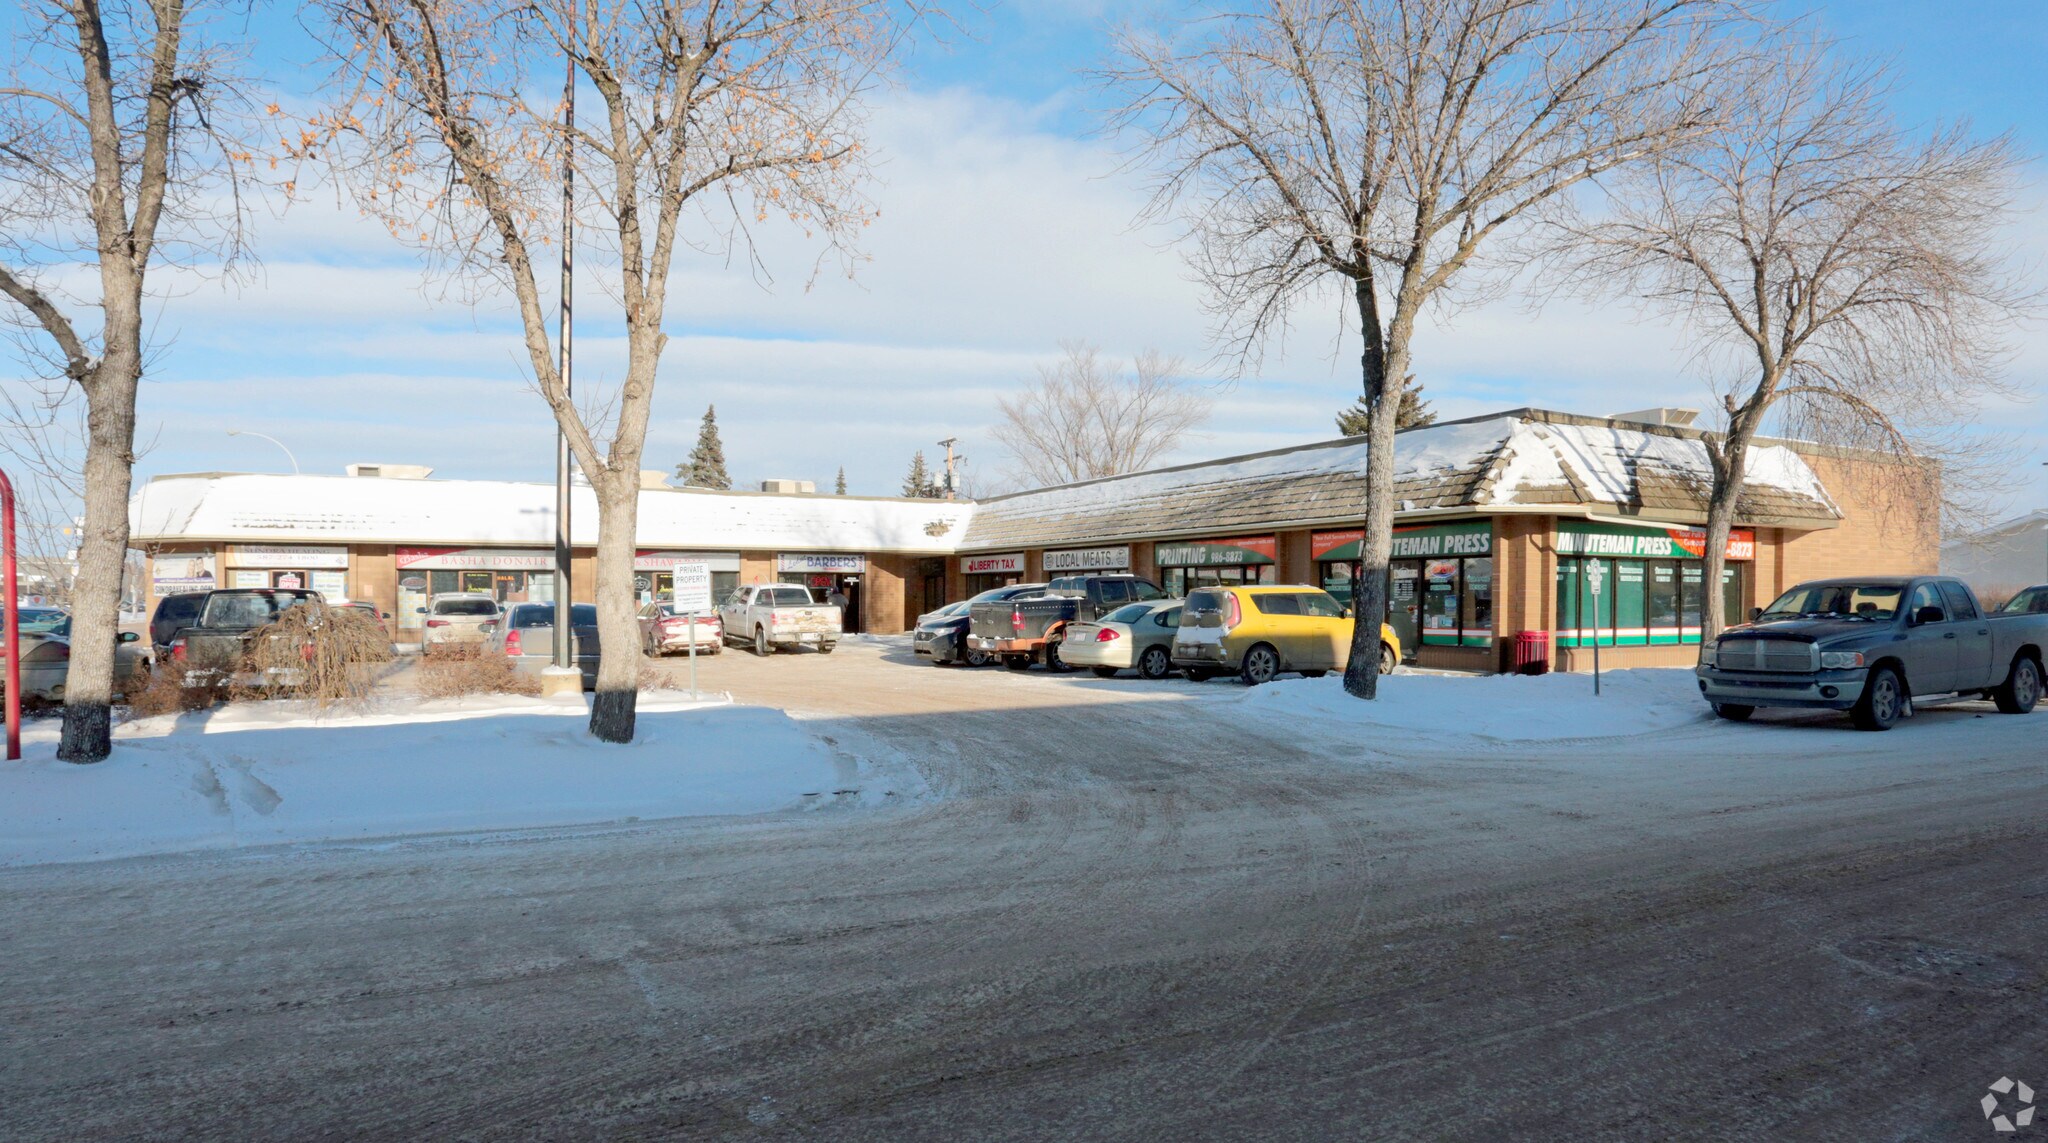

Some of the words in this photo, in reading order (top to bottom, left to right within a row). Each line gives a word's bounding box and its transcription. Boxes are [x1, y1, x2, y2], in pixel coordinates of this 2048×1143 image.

[1444, 533, 1490, 553] PRESS
[1557, 532, 1634, 554] MINUTEMAN
[1636, 536, 1673, 555] PRESS
[441, 556, 486, 565] BASHA
[493, 557, 547, 566] DONAIR
[1056, 553, 1080, 567] LOCAL
[1158, 546, 1206, 565] PRINTING
[1211, 551, 1243, 563] 986-8873
[807, 556, 857, 568] BARBERS
[974, 560, 999, 570] LIBERTY
[1001, 559, 1015, 569] TAX
[680, 565, 704, 574] PRIVATE
[676, 575, 707, 584] PROPERTY
